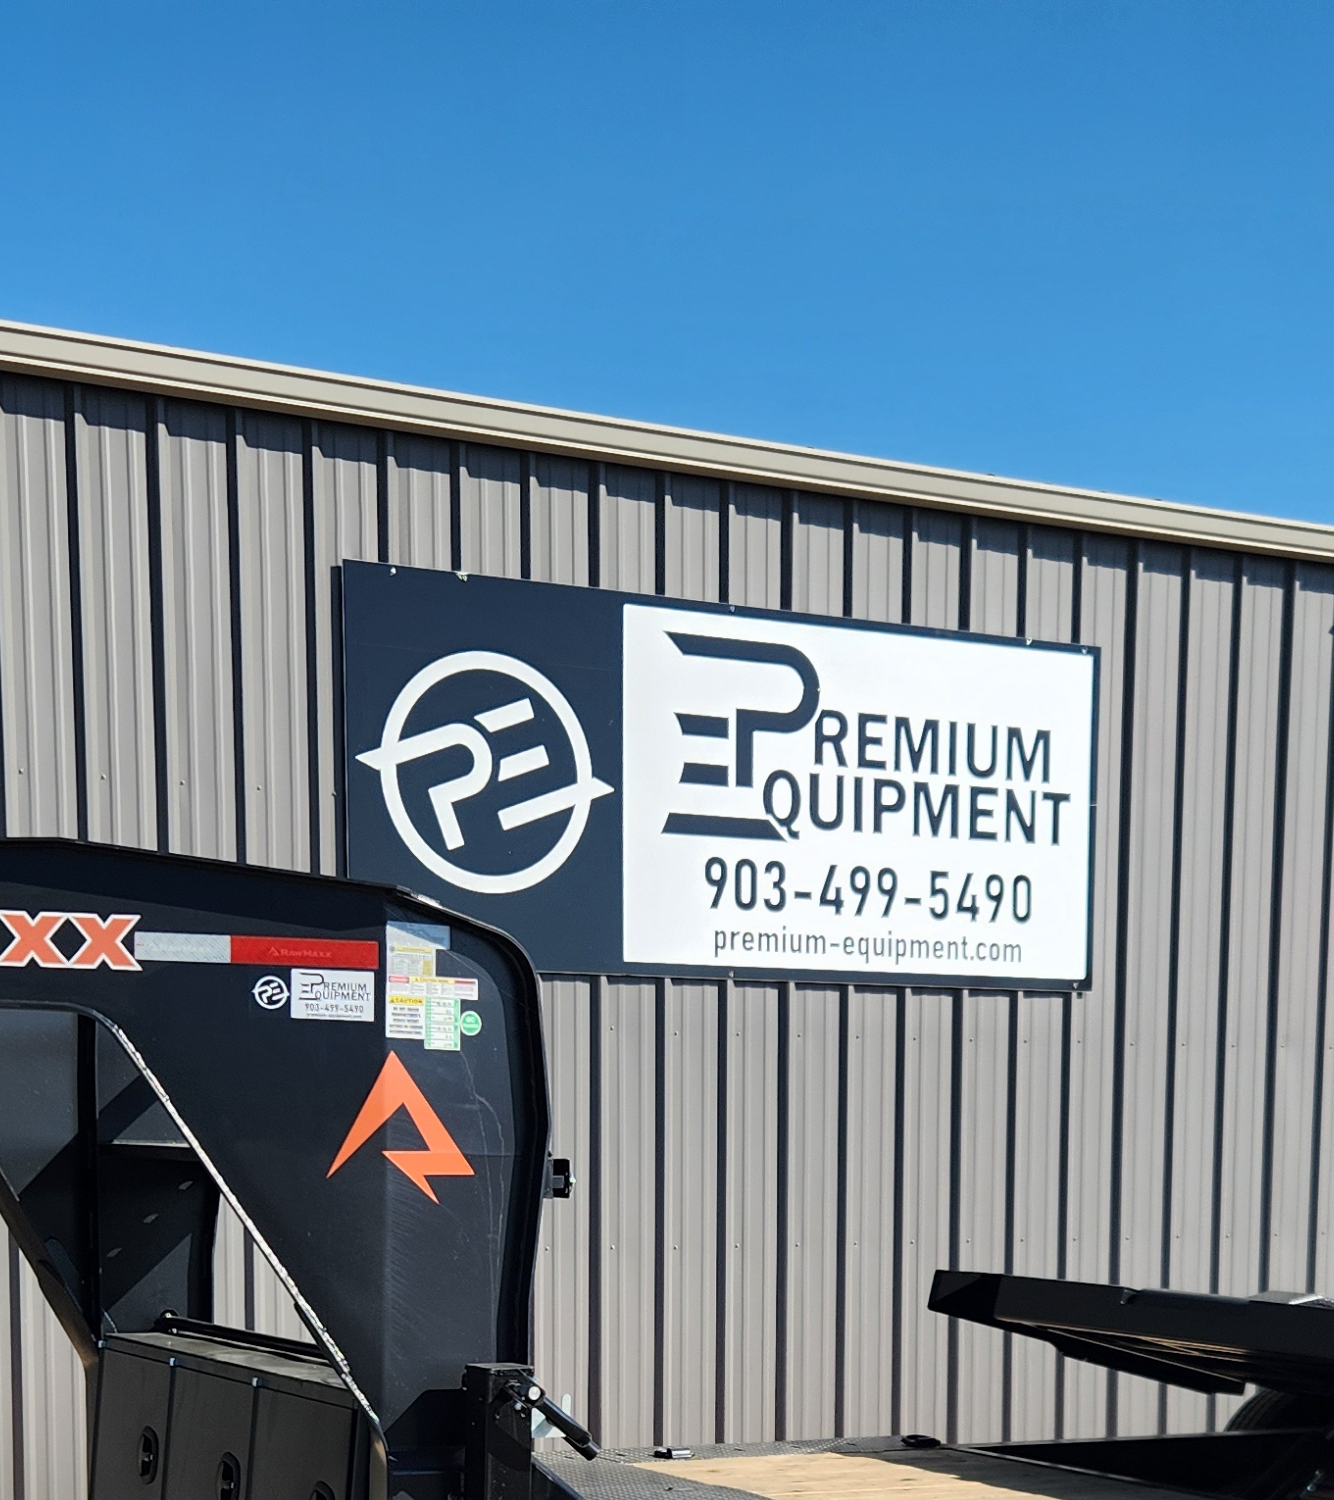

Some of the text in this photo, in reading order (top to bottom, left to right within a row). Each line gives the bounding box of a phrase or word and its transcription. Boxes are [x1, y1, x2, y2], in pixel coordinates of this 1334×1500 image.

[704, 856, 1034, 924] 903-499-5490
[713, 924, 1023, 965] premium-equipment.com
[305, 1003, 364, 1013] 903-499-5490
